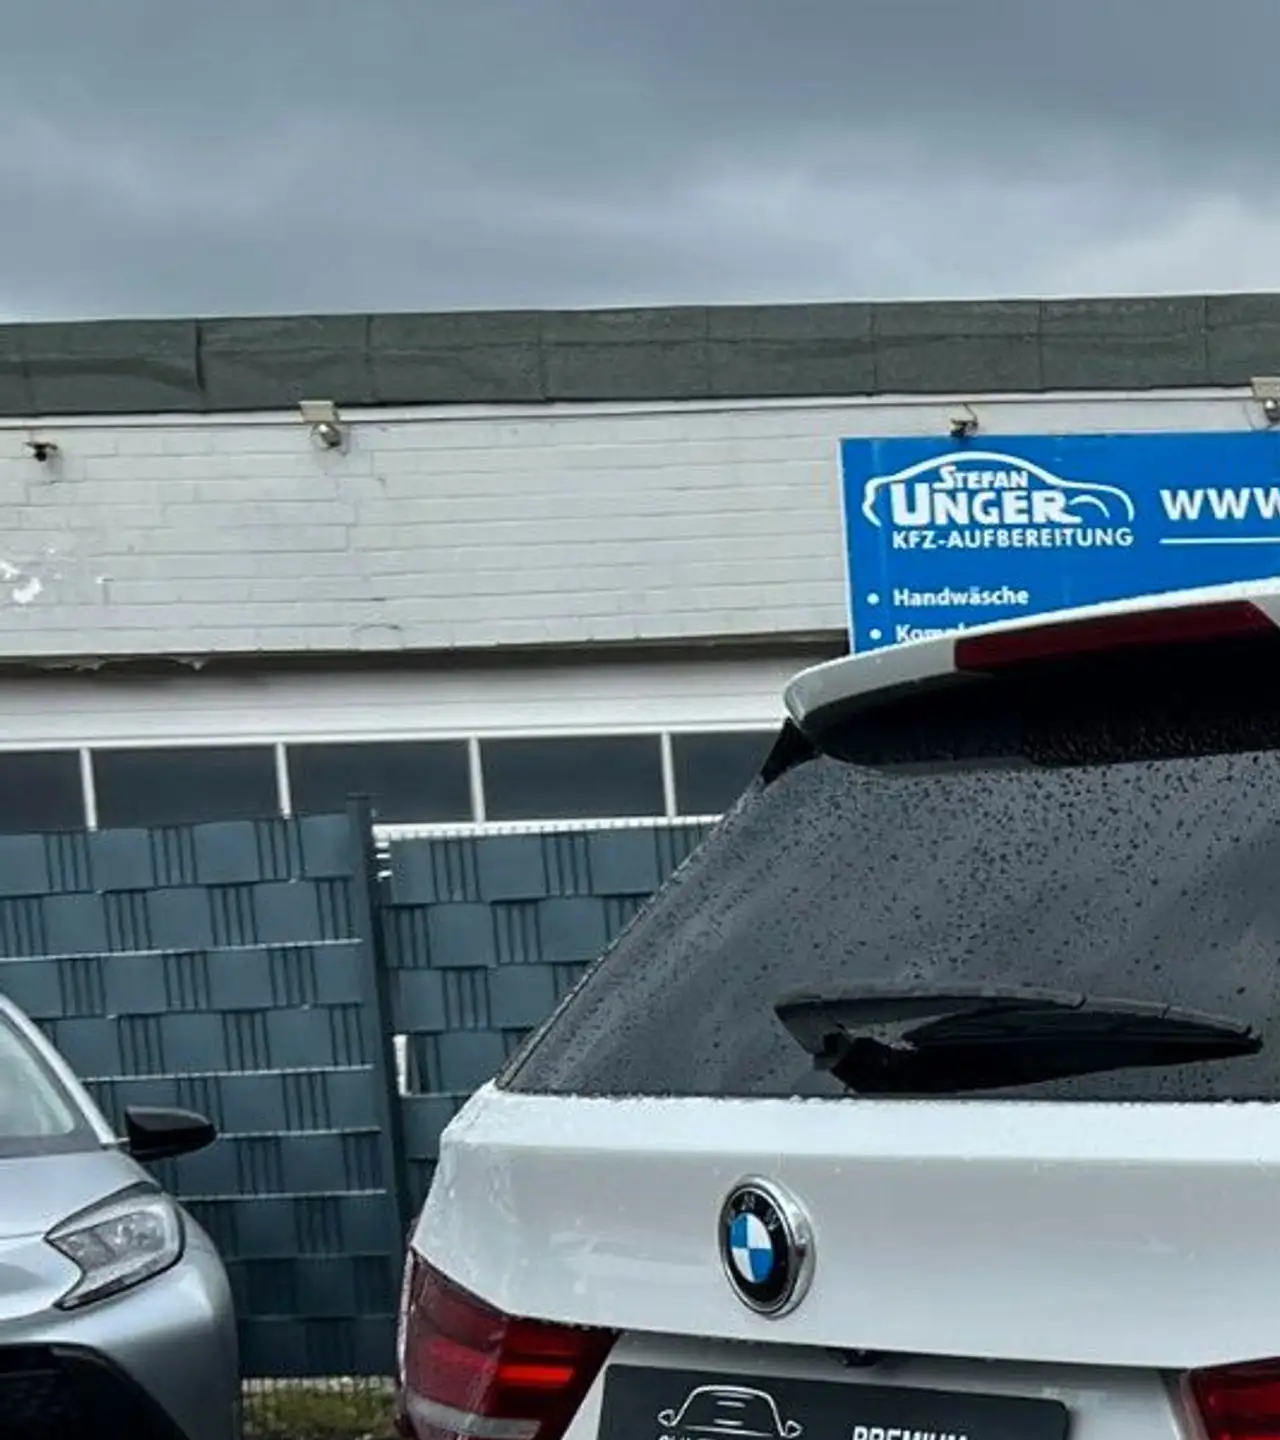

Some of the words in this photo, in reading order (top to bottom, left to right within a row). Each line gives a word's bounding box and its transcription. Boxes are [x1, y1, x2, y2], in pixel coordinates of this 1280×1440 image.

[932, 465, 1028, 489] STEFAN
[890, 482, 1083, 526] UNGER
[893, 527, 1134, 549] KFZ-AUFBEREITUNG
[893, 586, 1029, 606] Handwäsche
